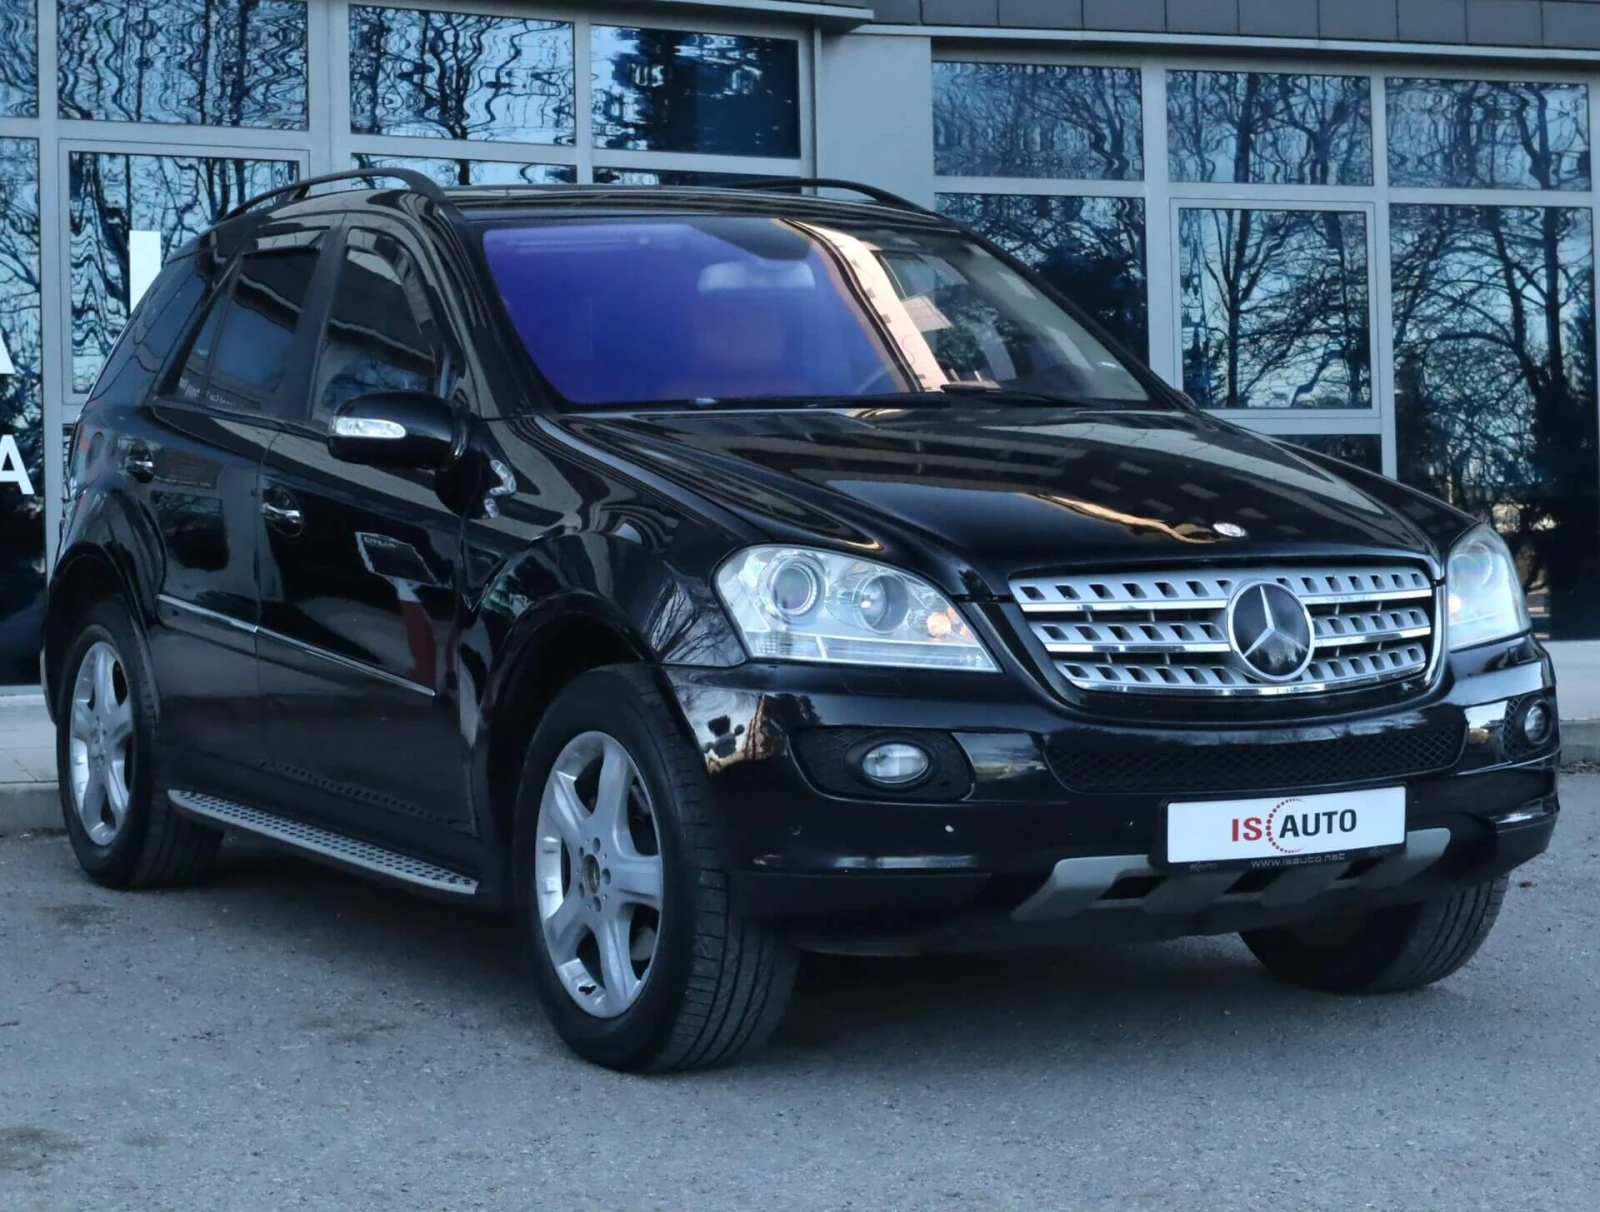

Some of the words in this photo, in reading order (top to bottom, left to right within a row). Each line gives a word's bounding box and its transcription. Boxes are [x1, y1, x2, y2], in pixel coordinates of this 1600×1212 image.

[1231, 817, 1263, 842] IS
[1279, 808, 1357, 838] AUTO
[1251, 853, 1346, 868] www.isauto.net
